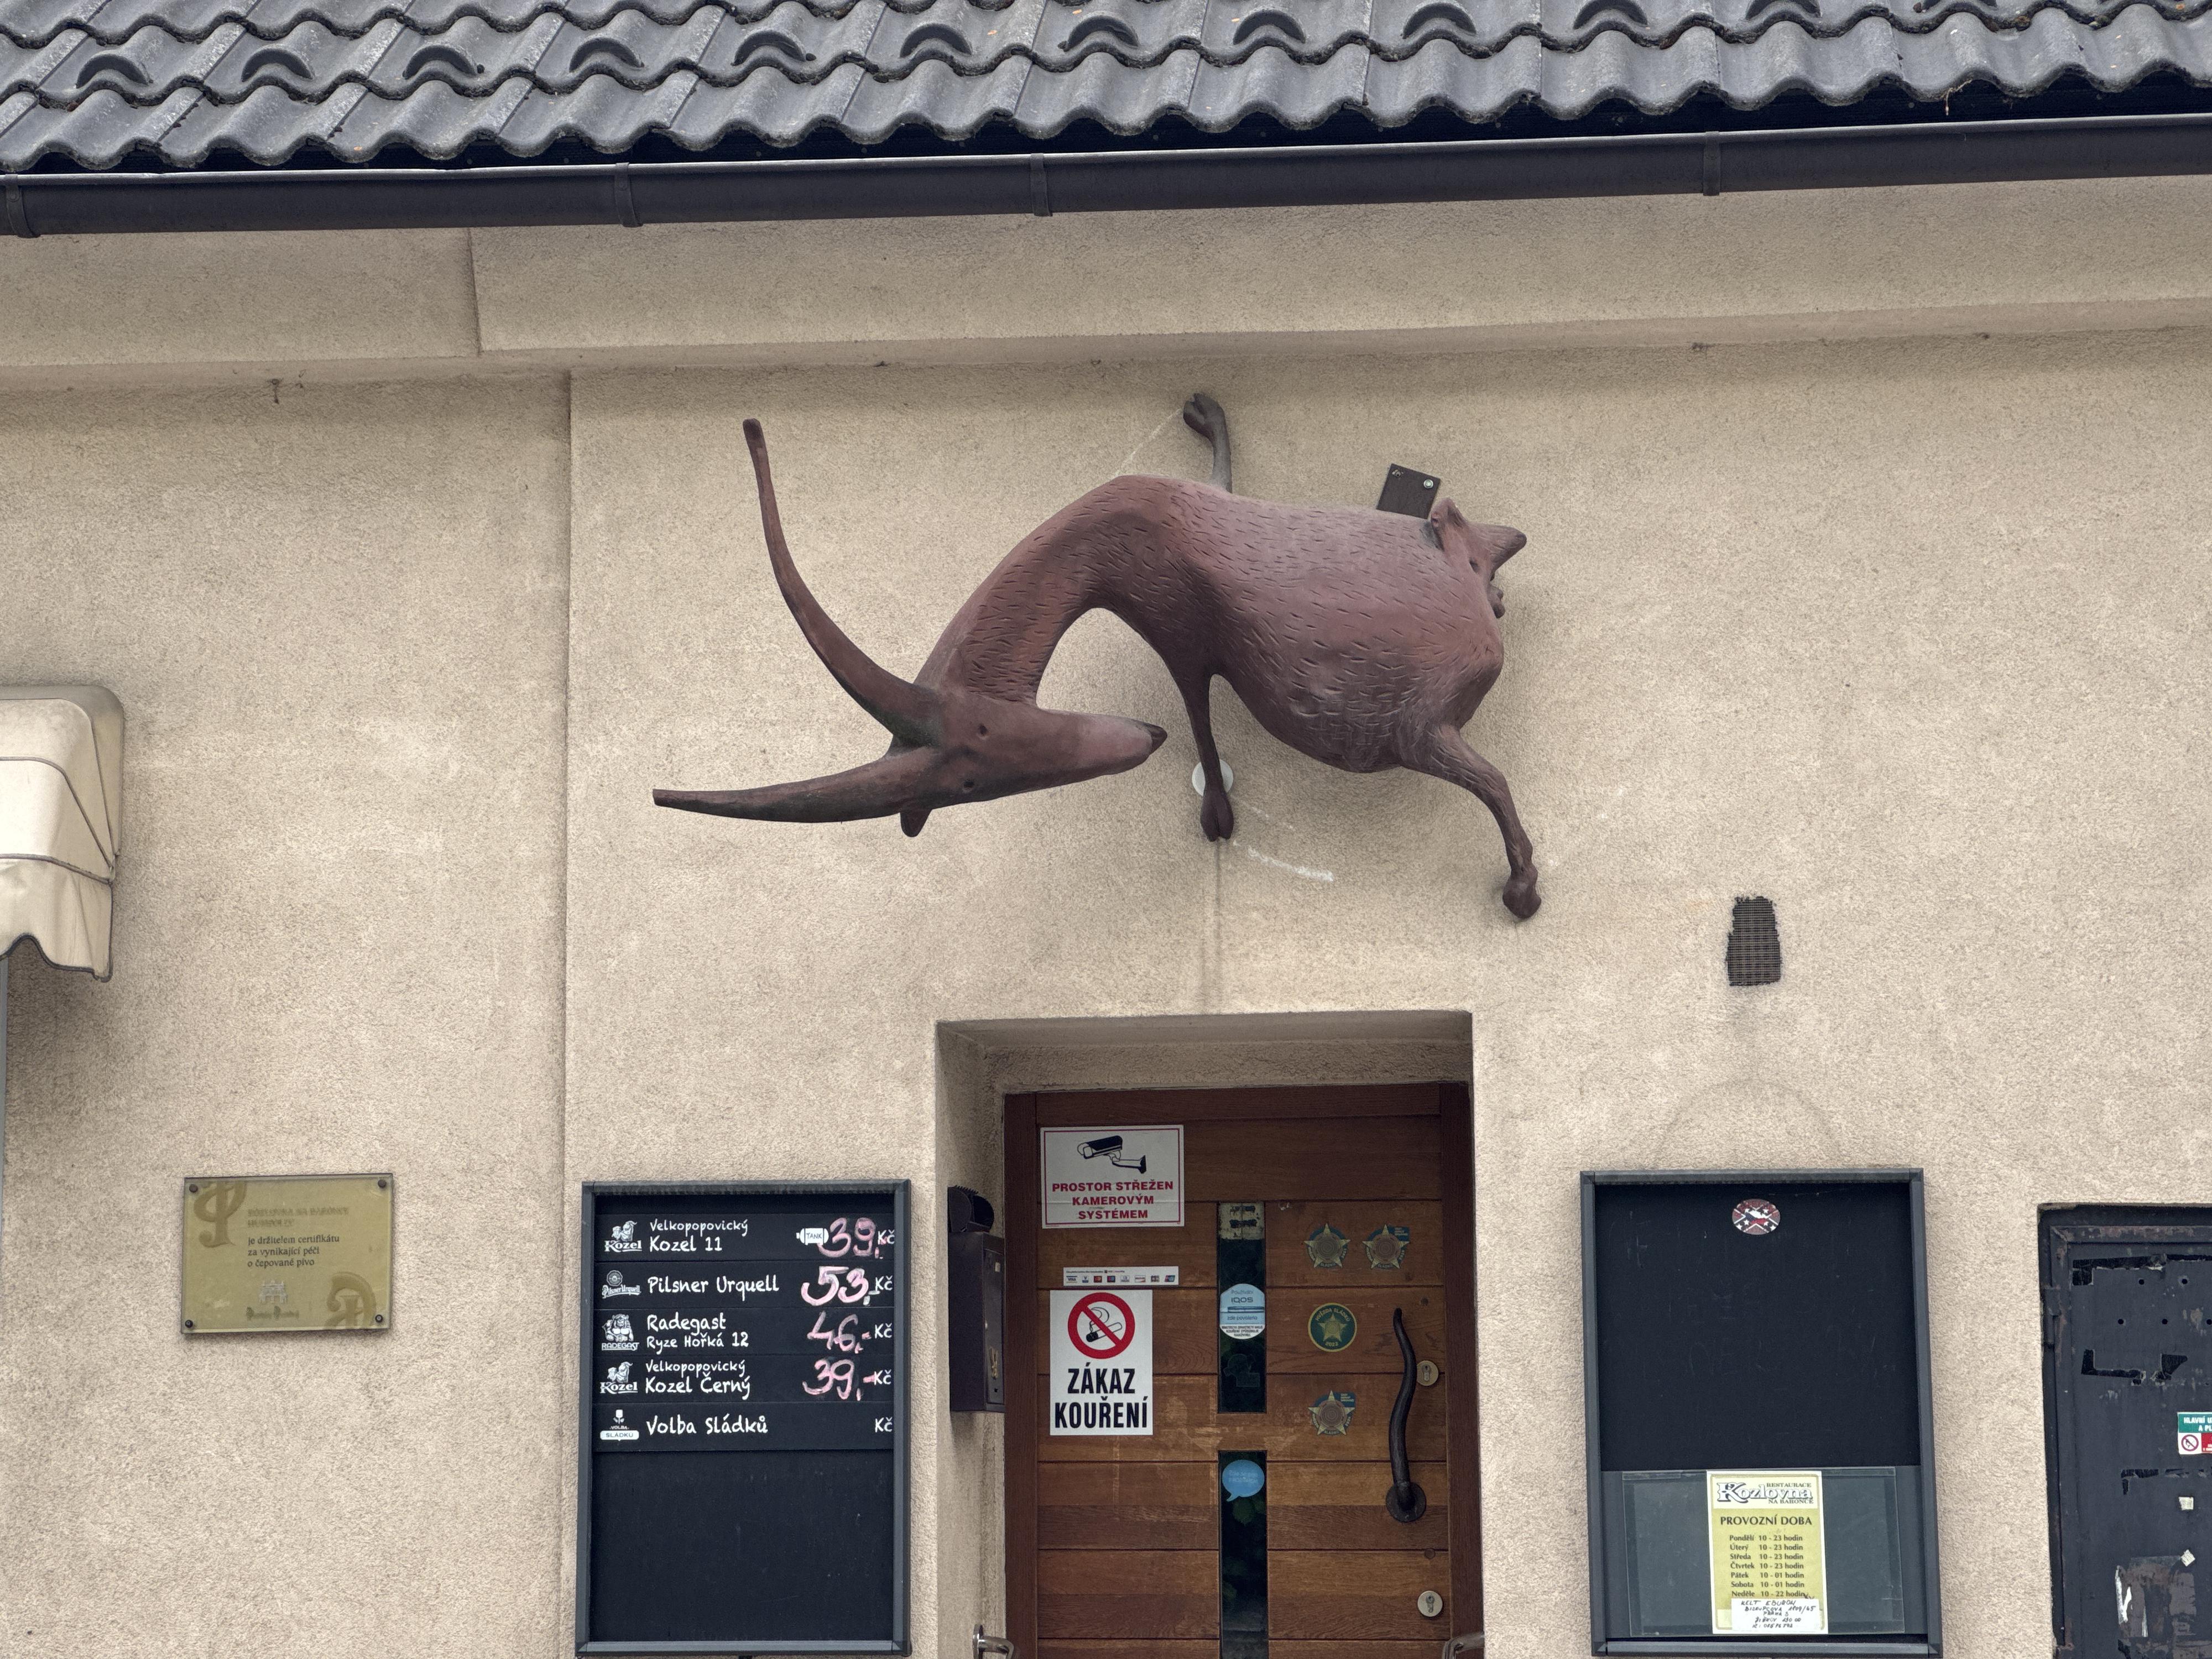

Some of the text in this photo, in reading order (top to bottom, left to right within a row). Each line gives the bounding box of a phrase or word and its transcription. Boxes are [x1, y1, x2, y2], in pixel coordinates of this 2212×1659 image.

[1052, 1179, 1173, 1192] PROSTOR STŘEŽEN
[1072, 1193, 1154, 1206] KAMEROVÝM
[1078, 1208, 1147, 1219] SYSTÉMEM
[650, 1218, 748, 1237] Velkopopovický
[248, 1234, 340, 1245] je držitelem certifikátu
[649, 1235, 722, 1252] Kozel 11
[878, 1229, 895, 1245] Kč
[260, 1247, 301, 1257] vynikající
[304, 1246, 319, 1256] péči
[604, 1240, 642, 1252] Kozel
[255, 1258, 294, 1269] čepované
[297, 1259, 315, 1267] pivo
[648, 1275, 779, 1301] Pilsner Urquell
[875, 1275, 893, 1291] Kč
[647, 1312, 726, 1335] Radegast
[874, 1323, 892, 1339] Kč
[602, 1342, 639, 1350] RADEGAST
[646, 1331, 749, 1354] Ryze Hořká 12
[646, 1359, 745, 1378] Velkopopovický
[874, 1369, 891, 1385] Kč
[1068, 1362, 1135, 1394] ZÁKAZ
[600, 1382, 638, 1394] Kozel
[645, 1371, 750, 1400] Kozel Černý
[1055, 1396, 1148, 1428] KOUŘENÍ
[646, 1413, 768, 1435] Volba Sládků
[875, 1417, 893, 1433] Kč
[1717, 1482, 1813, 1503] Kozlovna
[1720, 1514, 1777, 1525] PROVOZNÍ
[1730, 1543, 1749, 1551] Úterý
